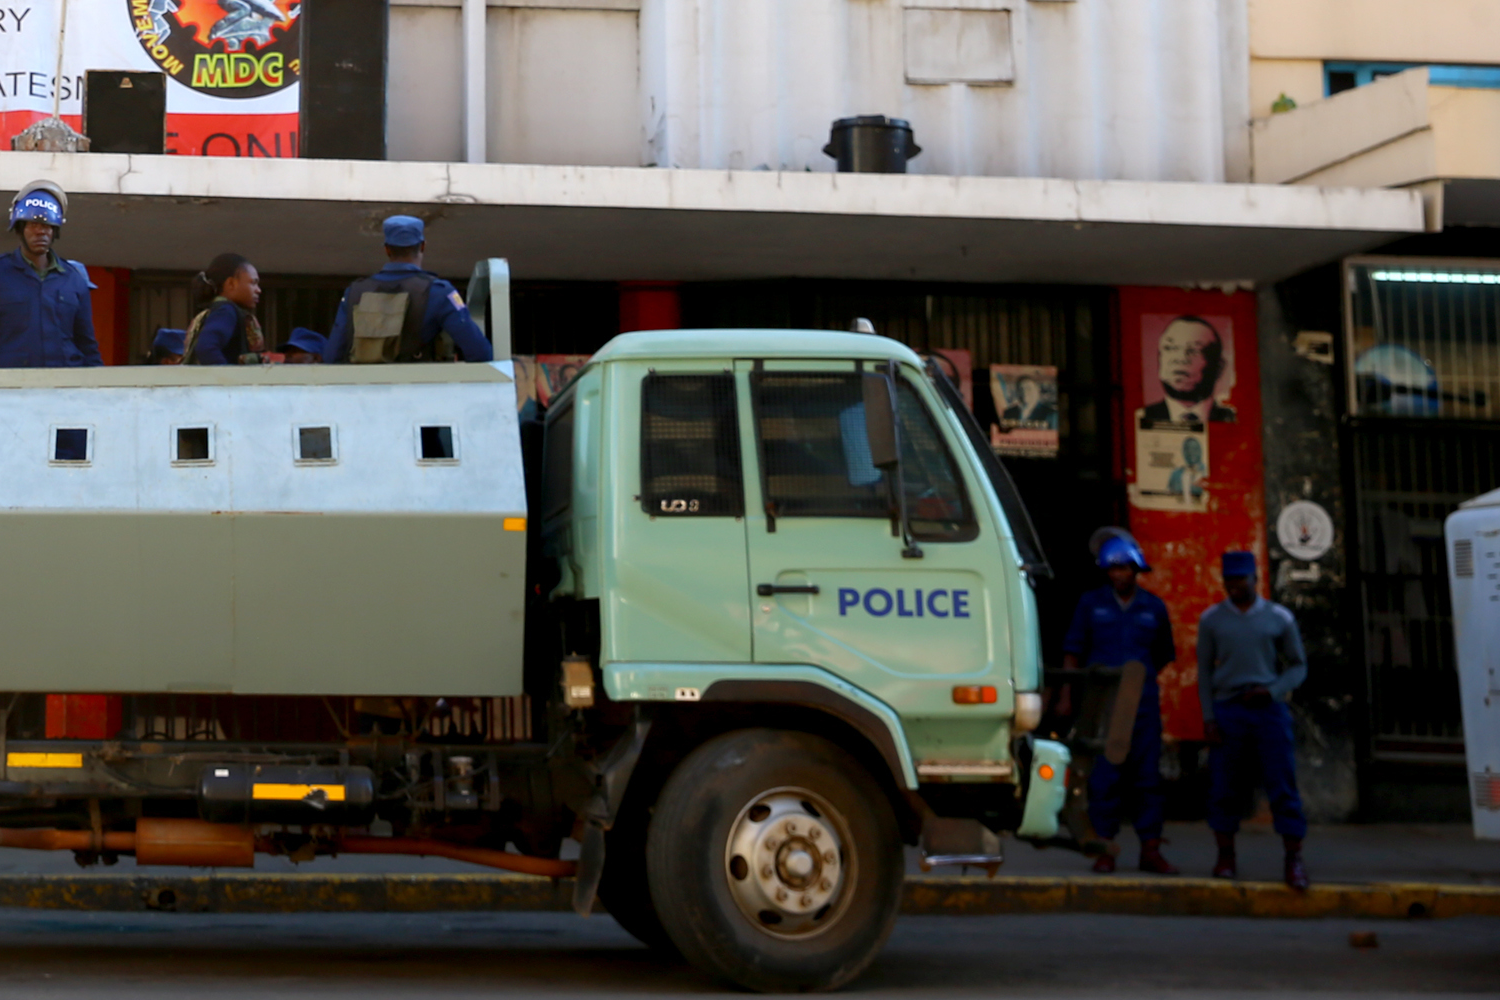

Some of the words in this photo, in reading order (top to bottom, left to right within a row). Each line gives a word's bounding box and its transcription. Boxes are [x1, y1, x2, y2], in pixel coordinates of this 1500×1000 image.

[191, 51, 284, 88] MDC
[25, 198, 58, 213] POLICE
[838, 587, 971, 618] POLICE
